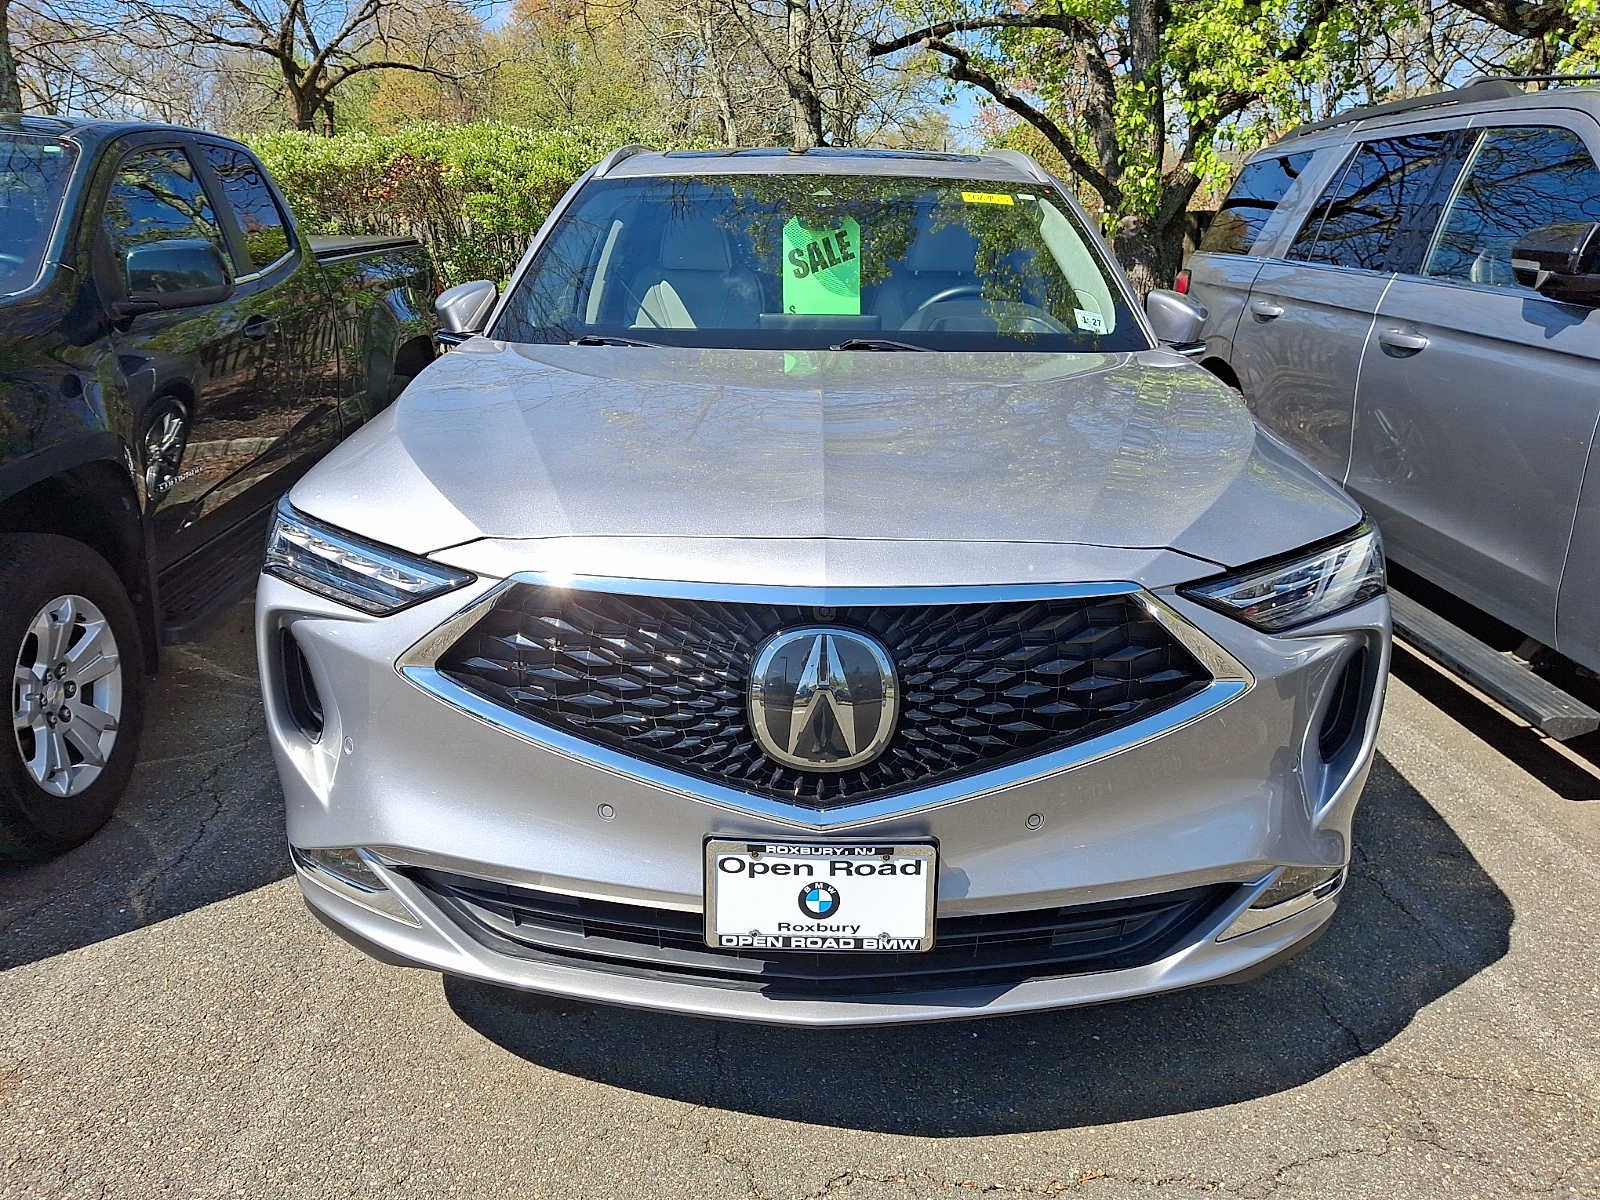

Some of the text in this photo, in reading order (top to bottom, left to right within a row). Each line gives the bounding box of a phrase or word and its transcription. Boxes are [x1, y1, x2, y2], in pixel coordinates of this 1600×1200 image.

[787, 229, 856, 280] SALE
[765, 845, 876, 856] ROXBURY, NJ
[718, 857, 922, 879] Open Road
[803, 882, 837, 895] BMW
[777, 922, 861, 934] Roxbury
[721, 935, 919, 950] OPEN ROAD BMW
